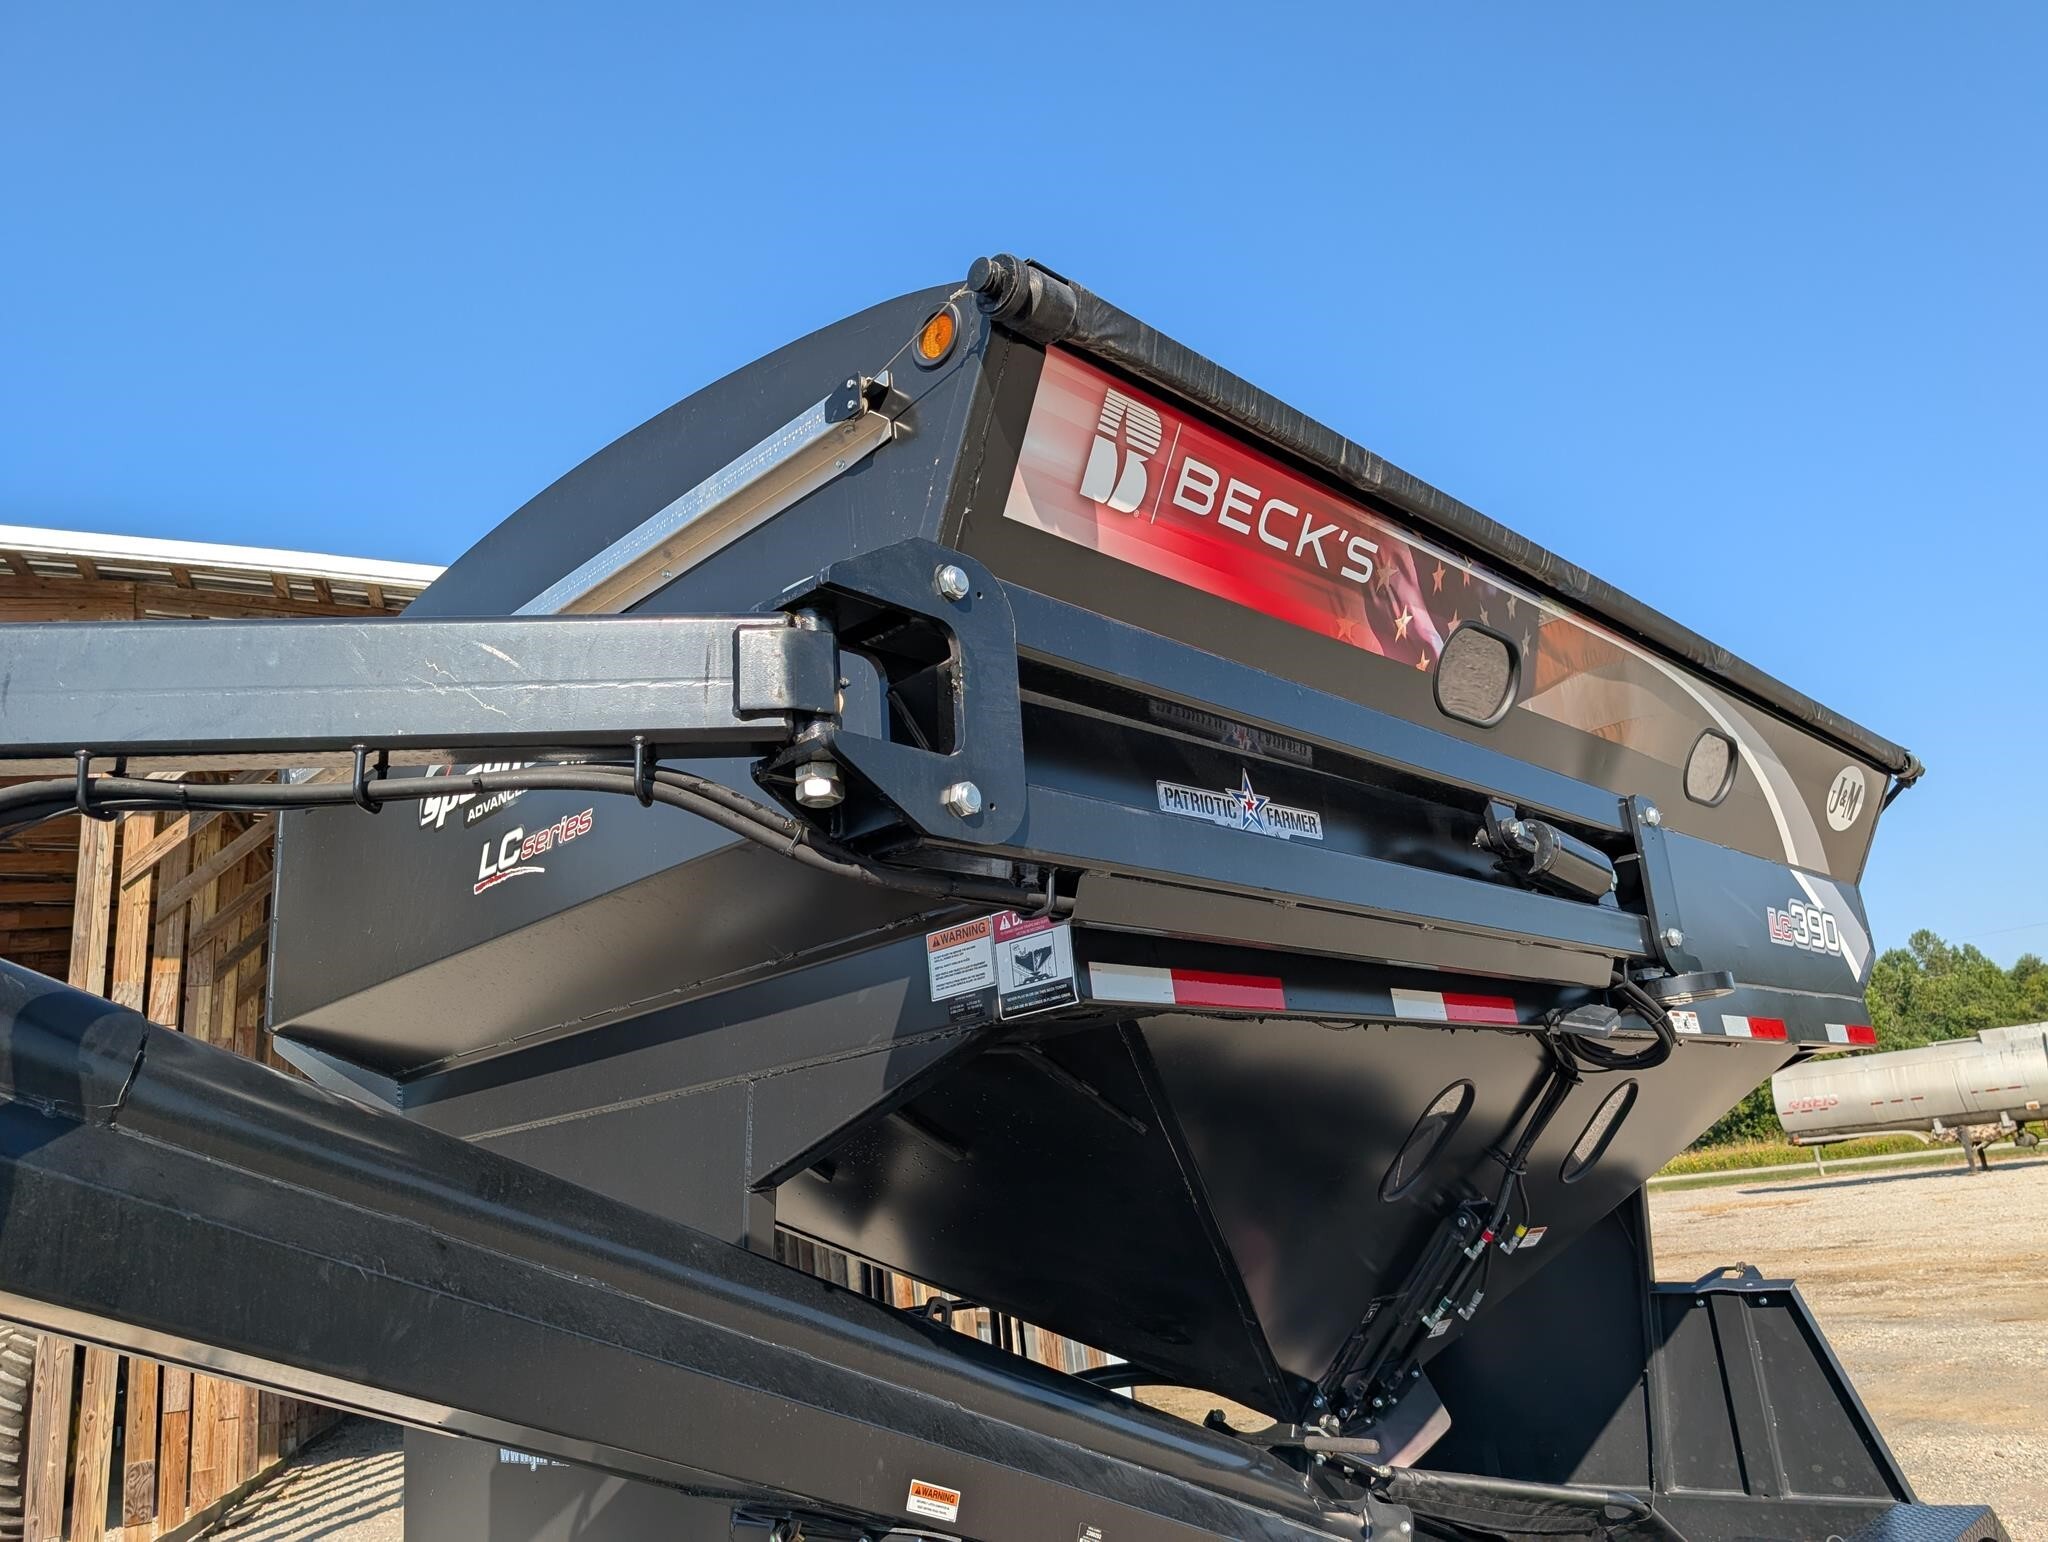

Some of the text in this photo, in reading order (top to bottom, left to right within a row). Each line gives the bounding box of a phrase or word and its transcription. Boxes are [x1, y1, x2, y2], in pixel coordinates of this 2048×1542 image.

[1172, 456, 1379, 585] BECK'S
[1163, 786, 1318, 835] PATRIOTIC FARMER
[1828, 776, 1863, 822] J&M
[940, 922, 986, 945] WARNING
[922, 1487, 956, 1504] WARNING
